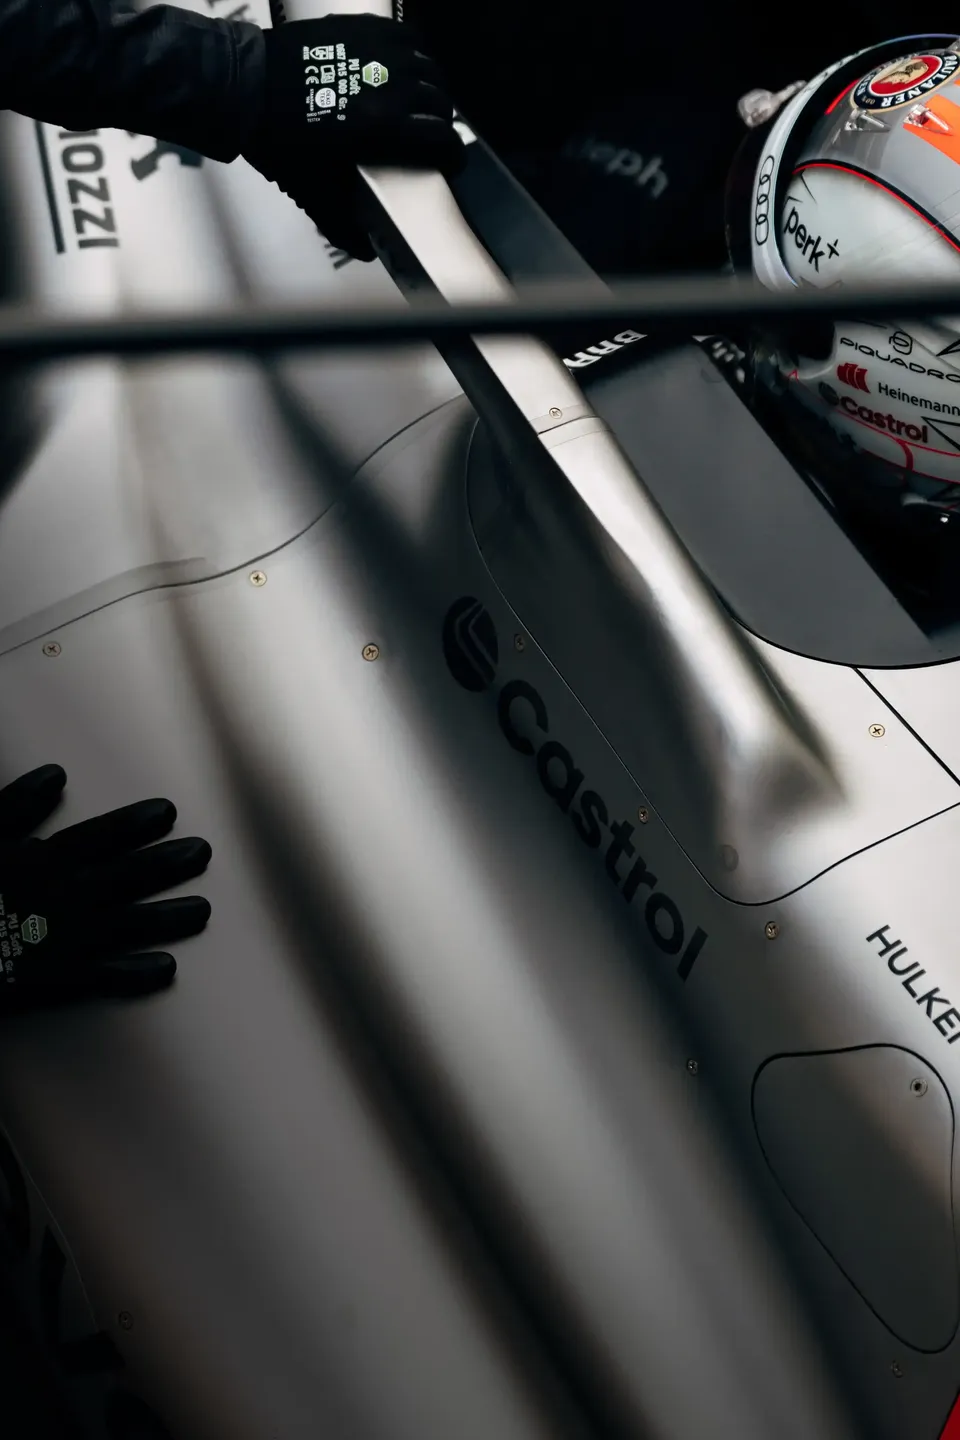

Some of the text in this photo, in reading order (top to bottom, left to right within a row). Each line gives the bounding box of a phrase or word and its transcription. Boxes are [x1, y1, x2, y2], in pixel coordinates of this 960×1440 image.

[348, 58, 361, 96] PU Soft
[881, 55, 958, 108] PAULANER
[58, 128, 121, 250] OZZI
[561, 328, 649, 372] BRA
[840, 337, 960, 383] PIQUADRO
[840, 396, 929, 444] Castrol
[877, 381, 960, 418] Heinemann
[497, 679, 709, 982] Castrol
[6, 912, 24, 957] PU Soft
[29, 917, 39, 941] reca
[865, 924, 960, 1045] HULKE
